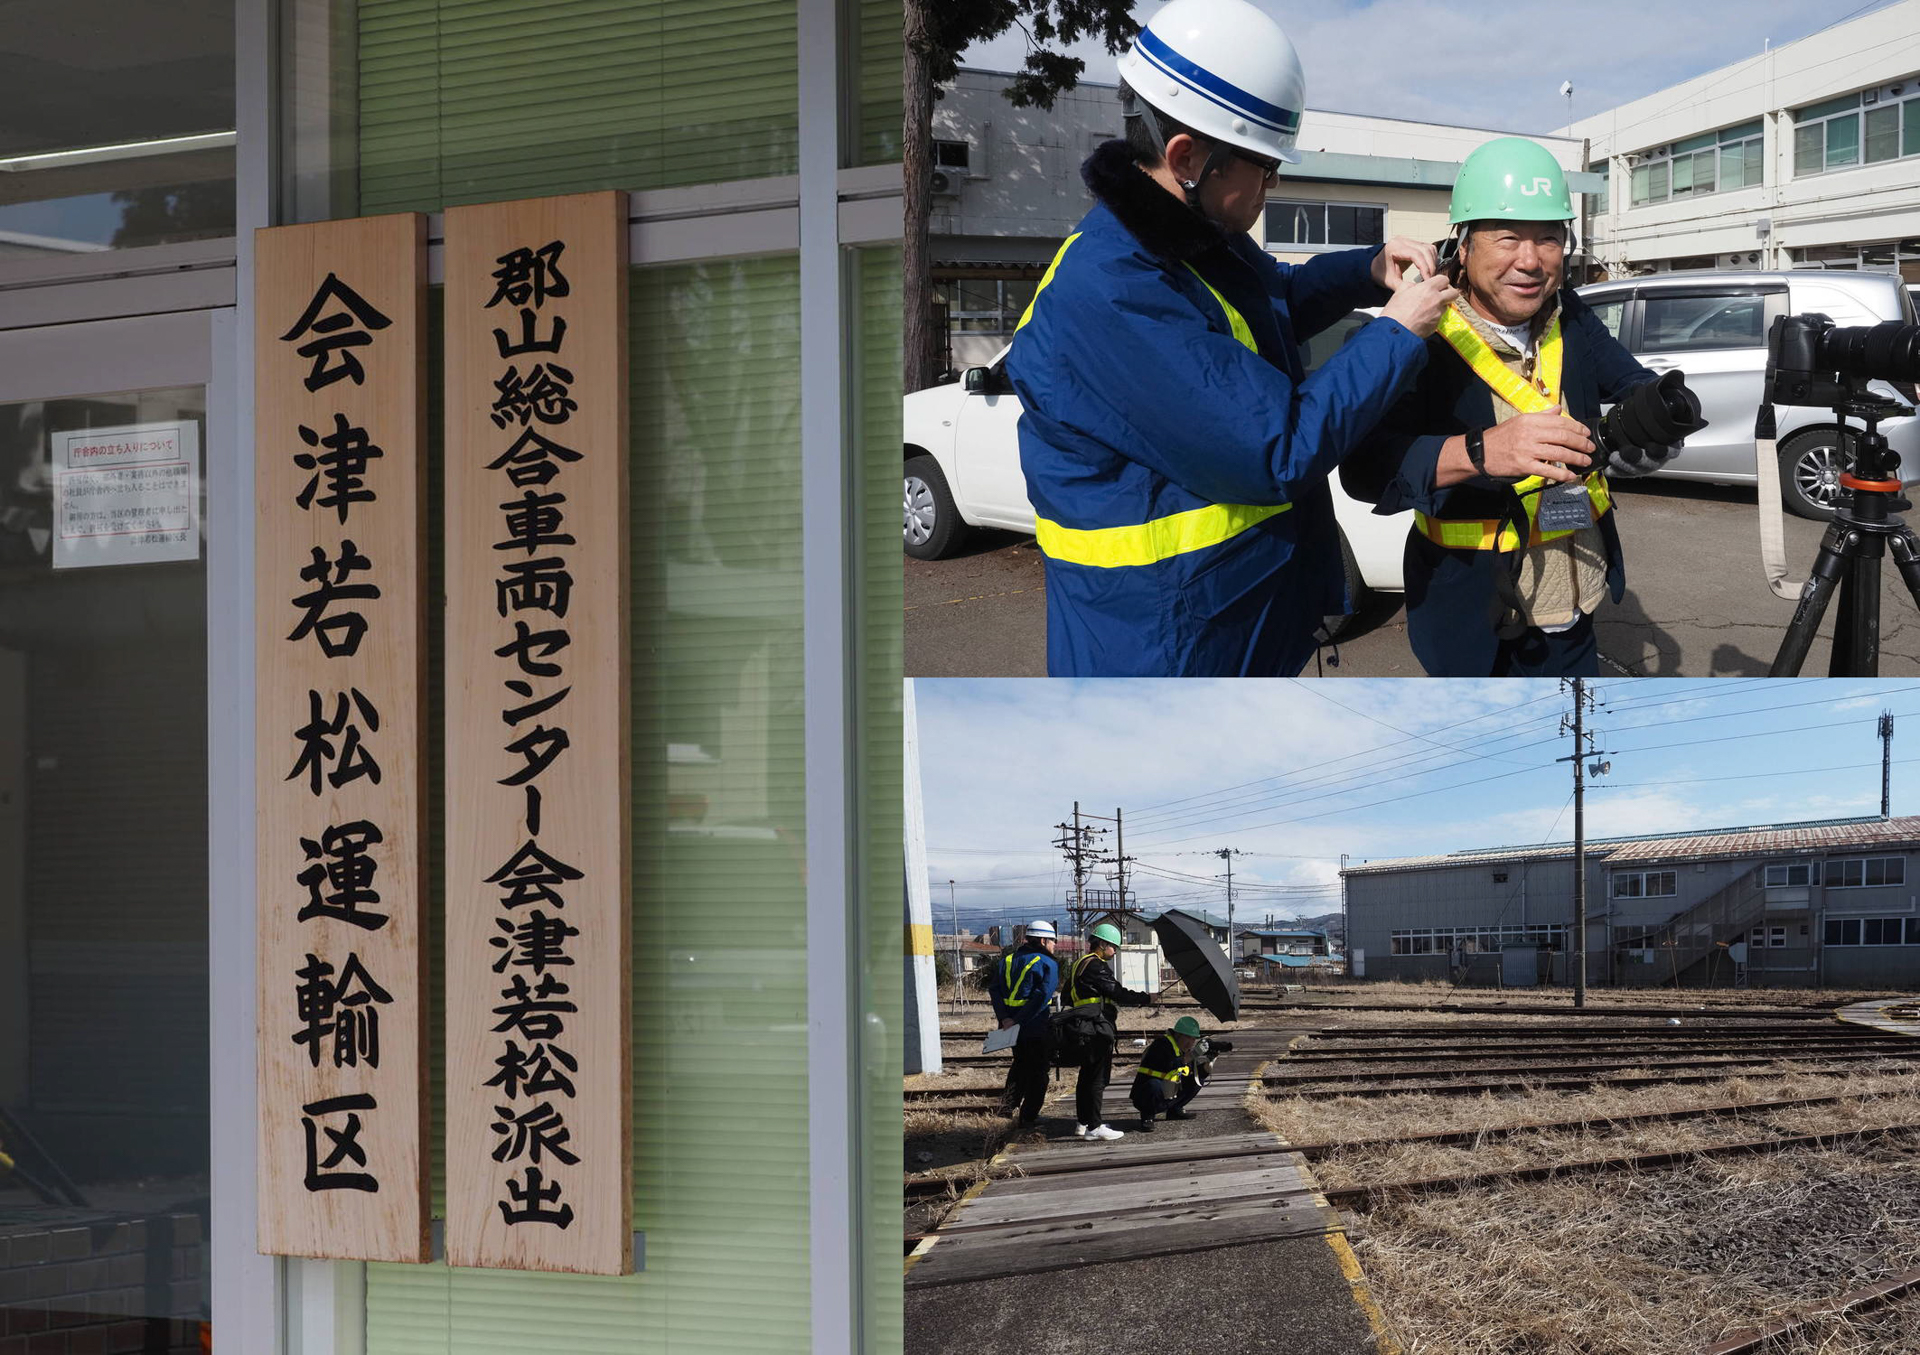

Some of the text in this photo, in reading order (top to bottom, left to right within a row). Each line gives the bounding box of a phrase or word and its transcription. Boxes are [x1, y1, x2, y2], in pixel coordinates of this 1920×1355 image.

[1520, 177, 1553, 197] JR
[73, 439, 174, 459] 庁舎内の立ち入りについて
[278, 271, 395, 1194] 会津若松運輸区
[482, 239, 585, 1230] 郡山総合車両センター会津若松派出
